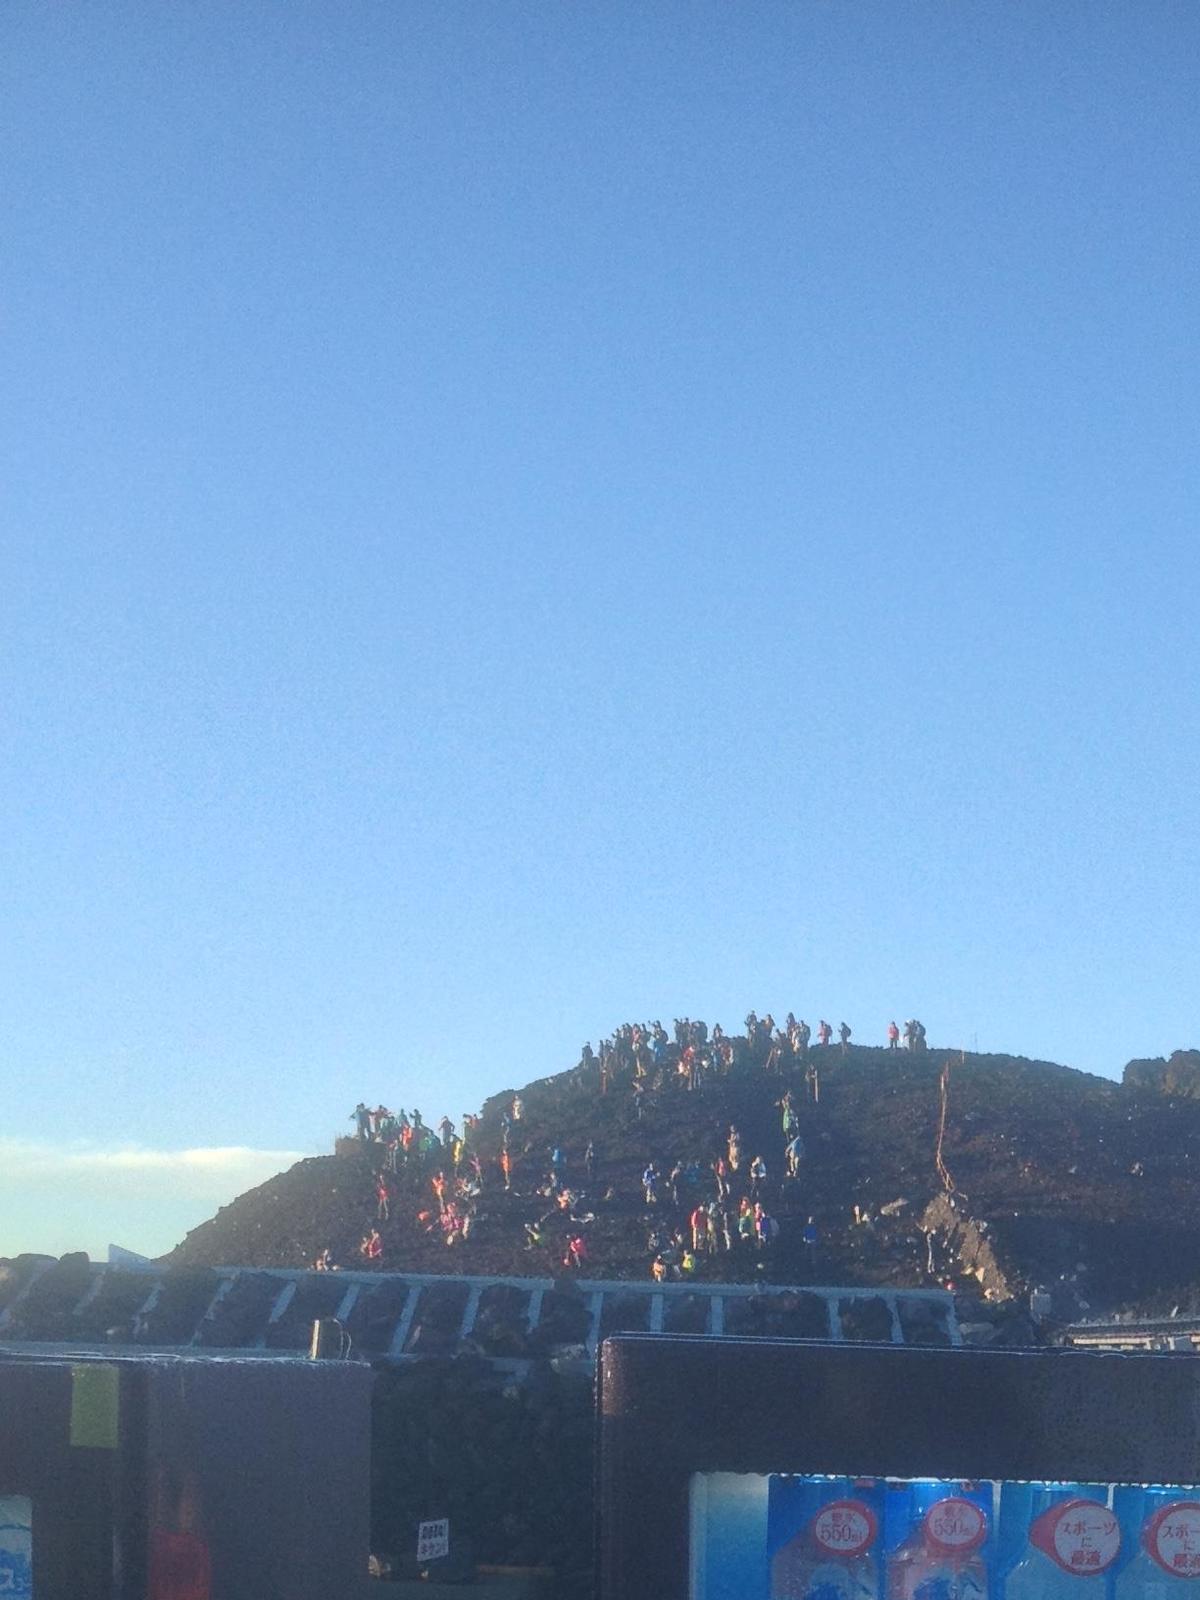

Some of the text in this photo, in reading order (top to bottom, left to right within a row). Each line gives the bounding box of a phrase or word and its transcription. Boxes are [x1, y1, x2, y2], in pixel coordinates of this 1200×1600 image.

[1063, 1521, 1116, 1536] スポーツ
[1081, 1537, 1092, 1548] に
